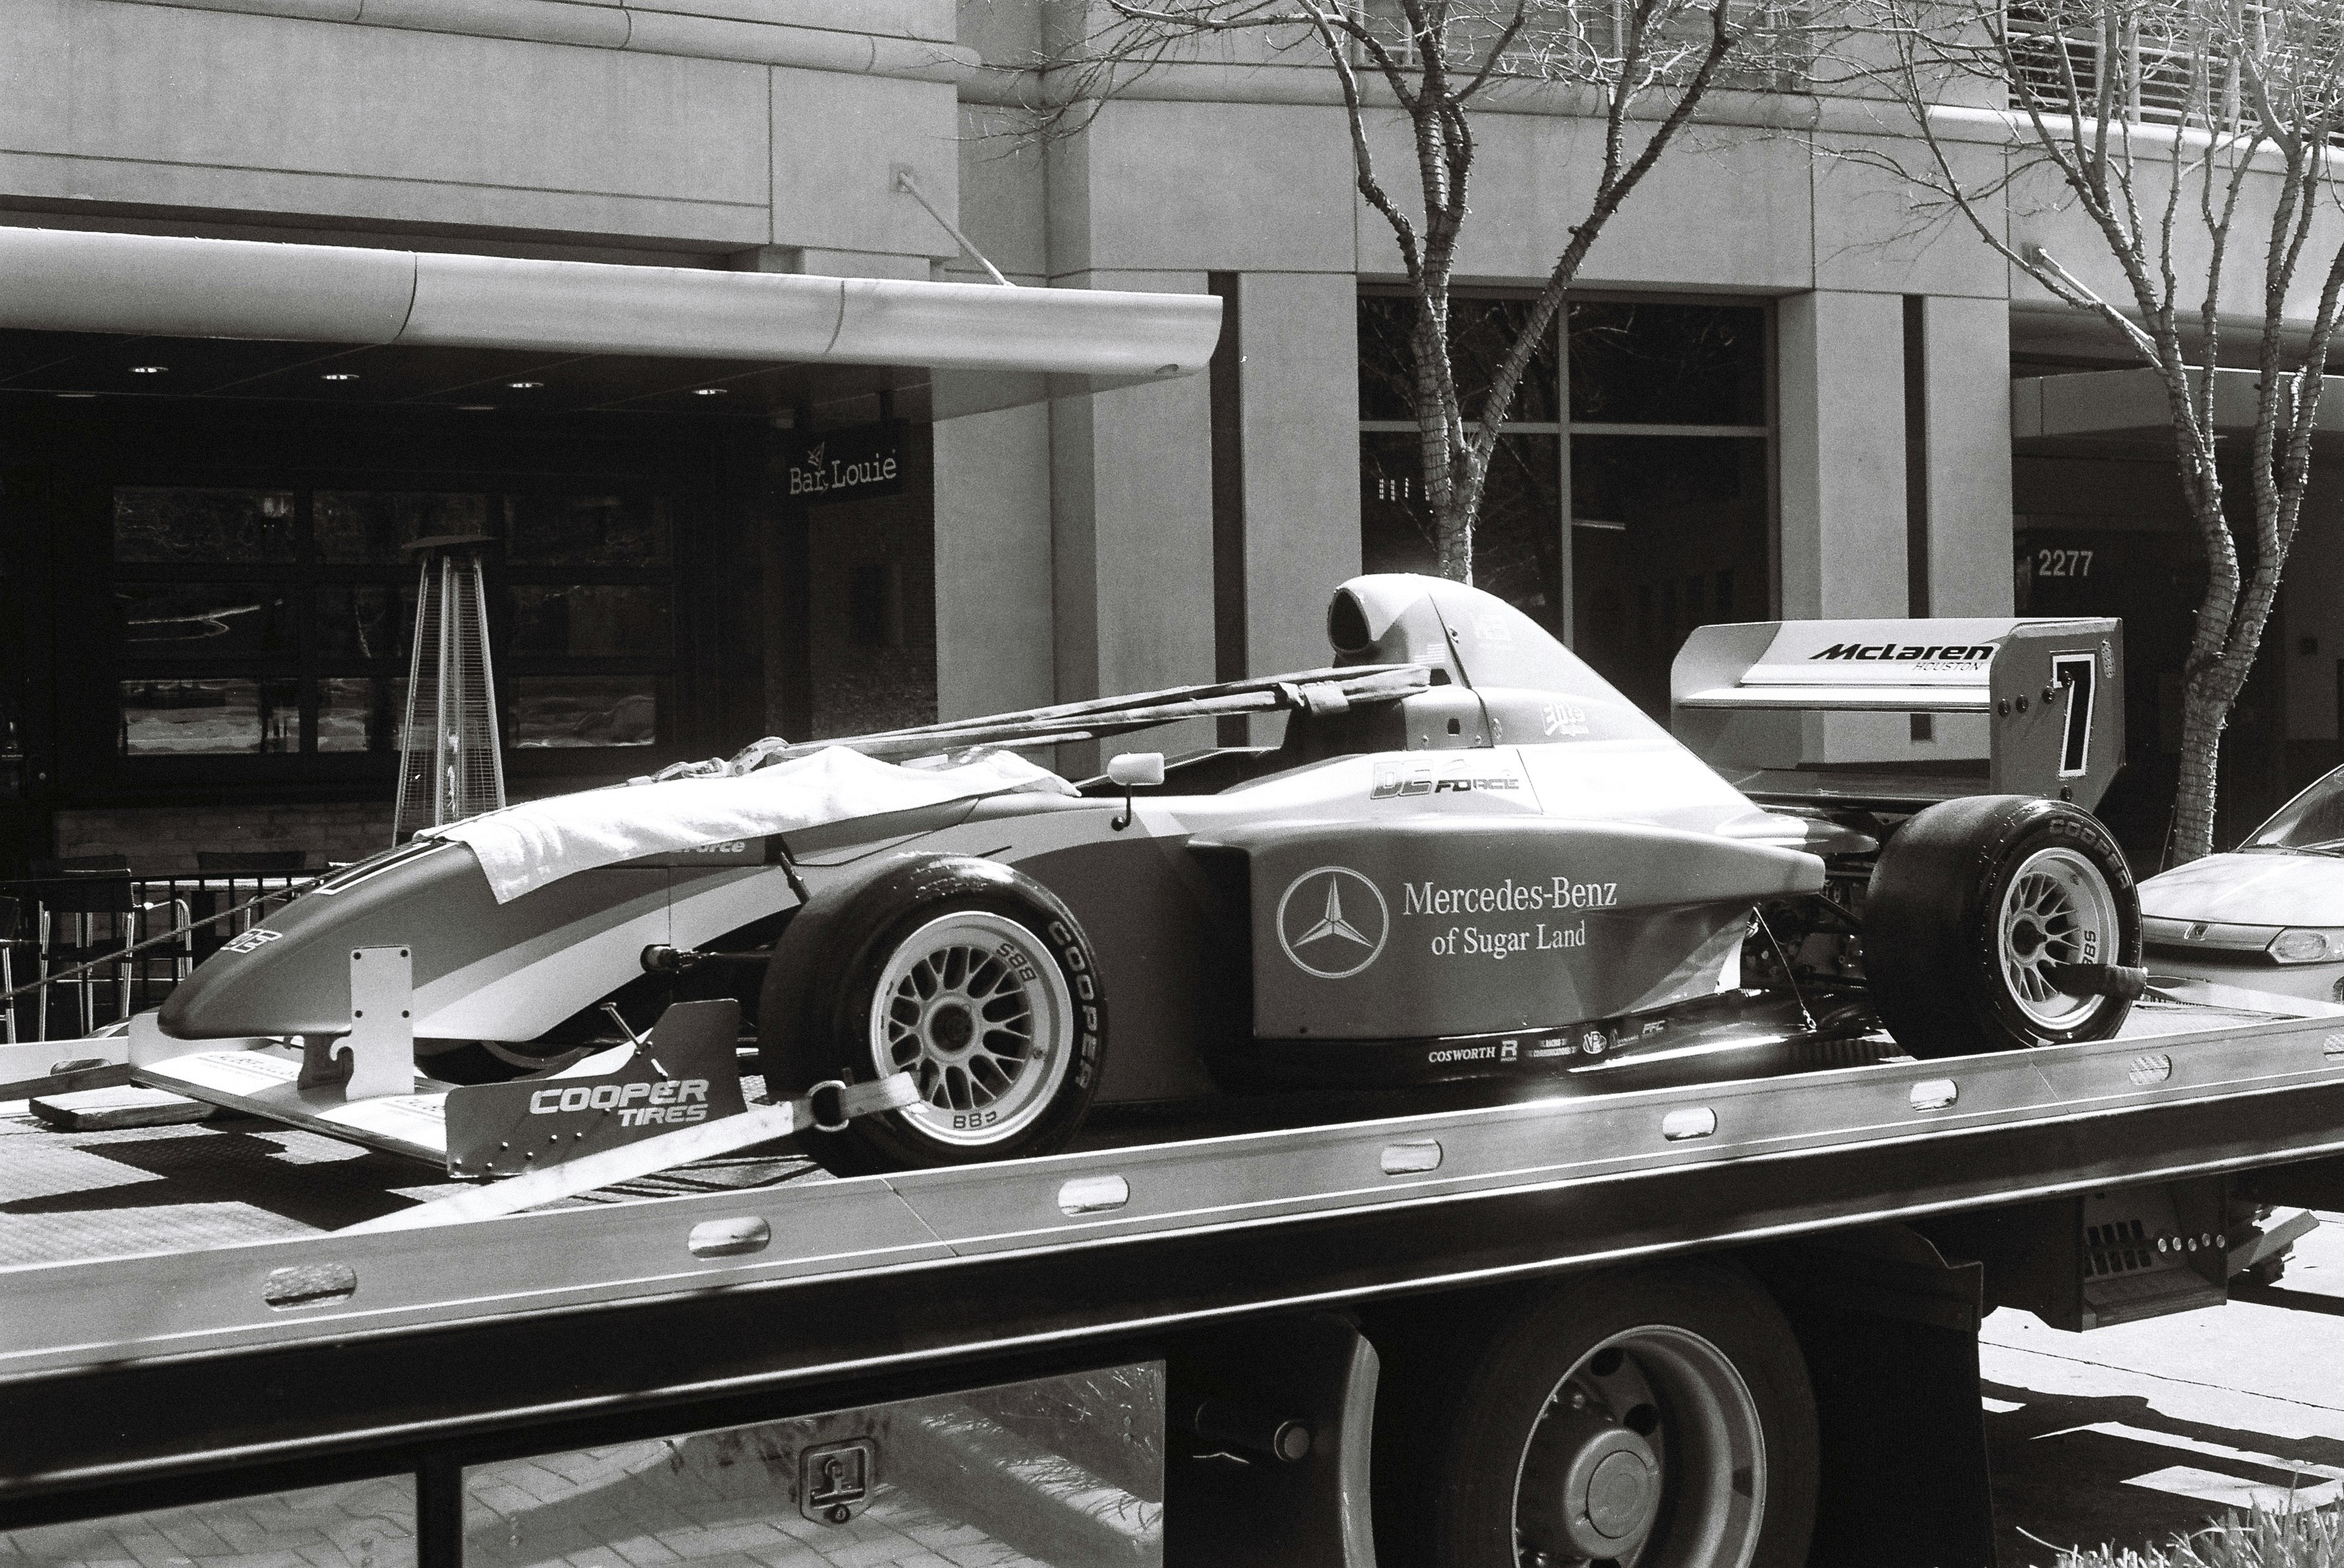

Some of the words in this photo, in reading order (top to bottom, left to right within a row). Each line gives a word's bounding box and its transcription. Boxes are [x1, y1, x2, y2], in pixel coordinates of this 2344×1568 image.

[790, 468, 826, 494] Bar
[832, 453, 896, 488] Louie
[2038, 549, 2093, 576] 2277
[1808, 643, 1994, 660] McLaren
[1911, 662, 1985, 671] HOUSTON
[1403, 877, 1618, 915] Mercedes-Benz
[1431, 927, 1459, 955] of
[1463, 927, 1530, 960] Sugar
[1536, 920, 1586, 950] Land
[1428, 1045, 1496, 1063] COSWORTH
[529, 1079, 709, 1115] COOPER
[618, 1103, 709, 1127] TIRES
